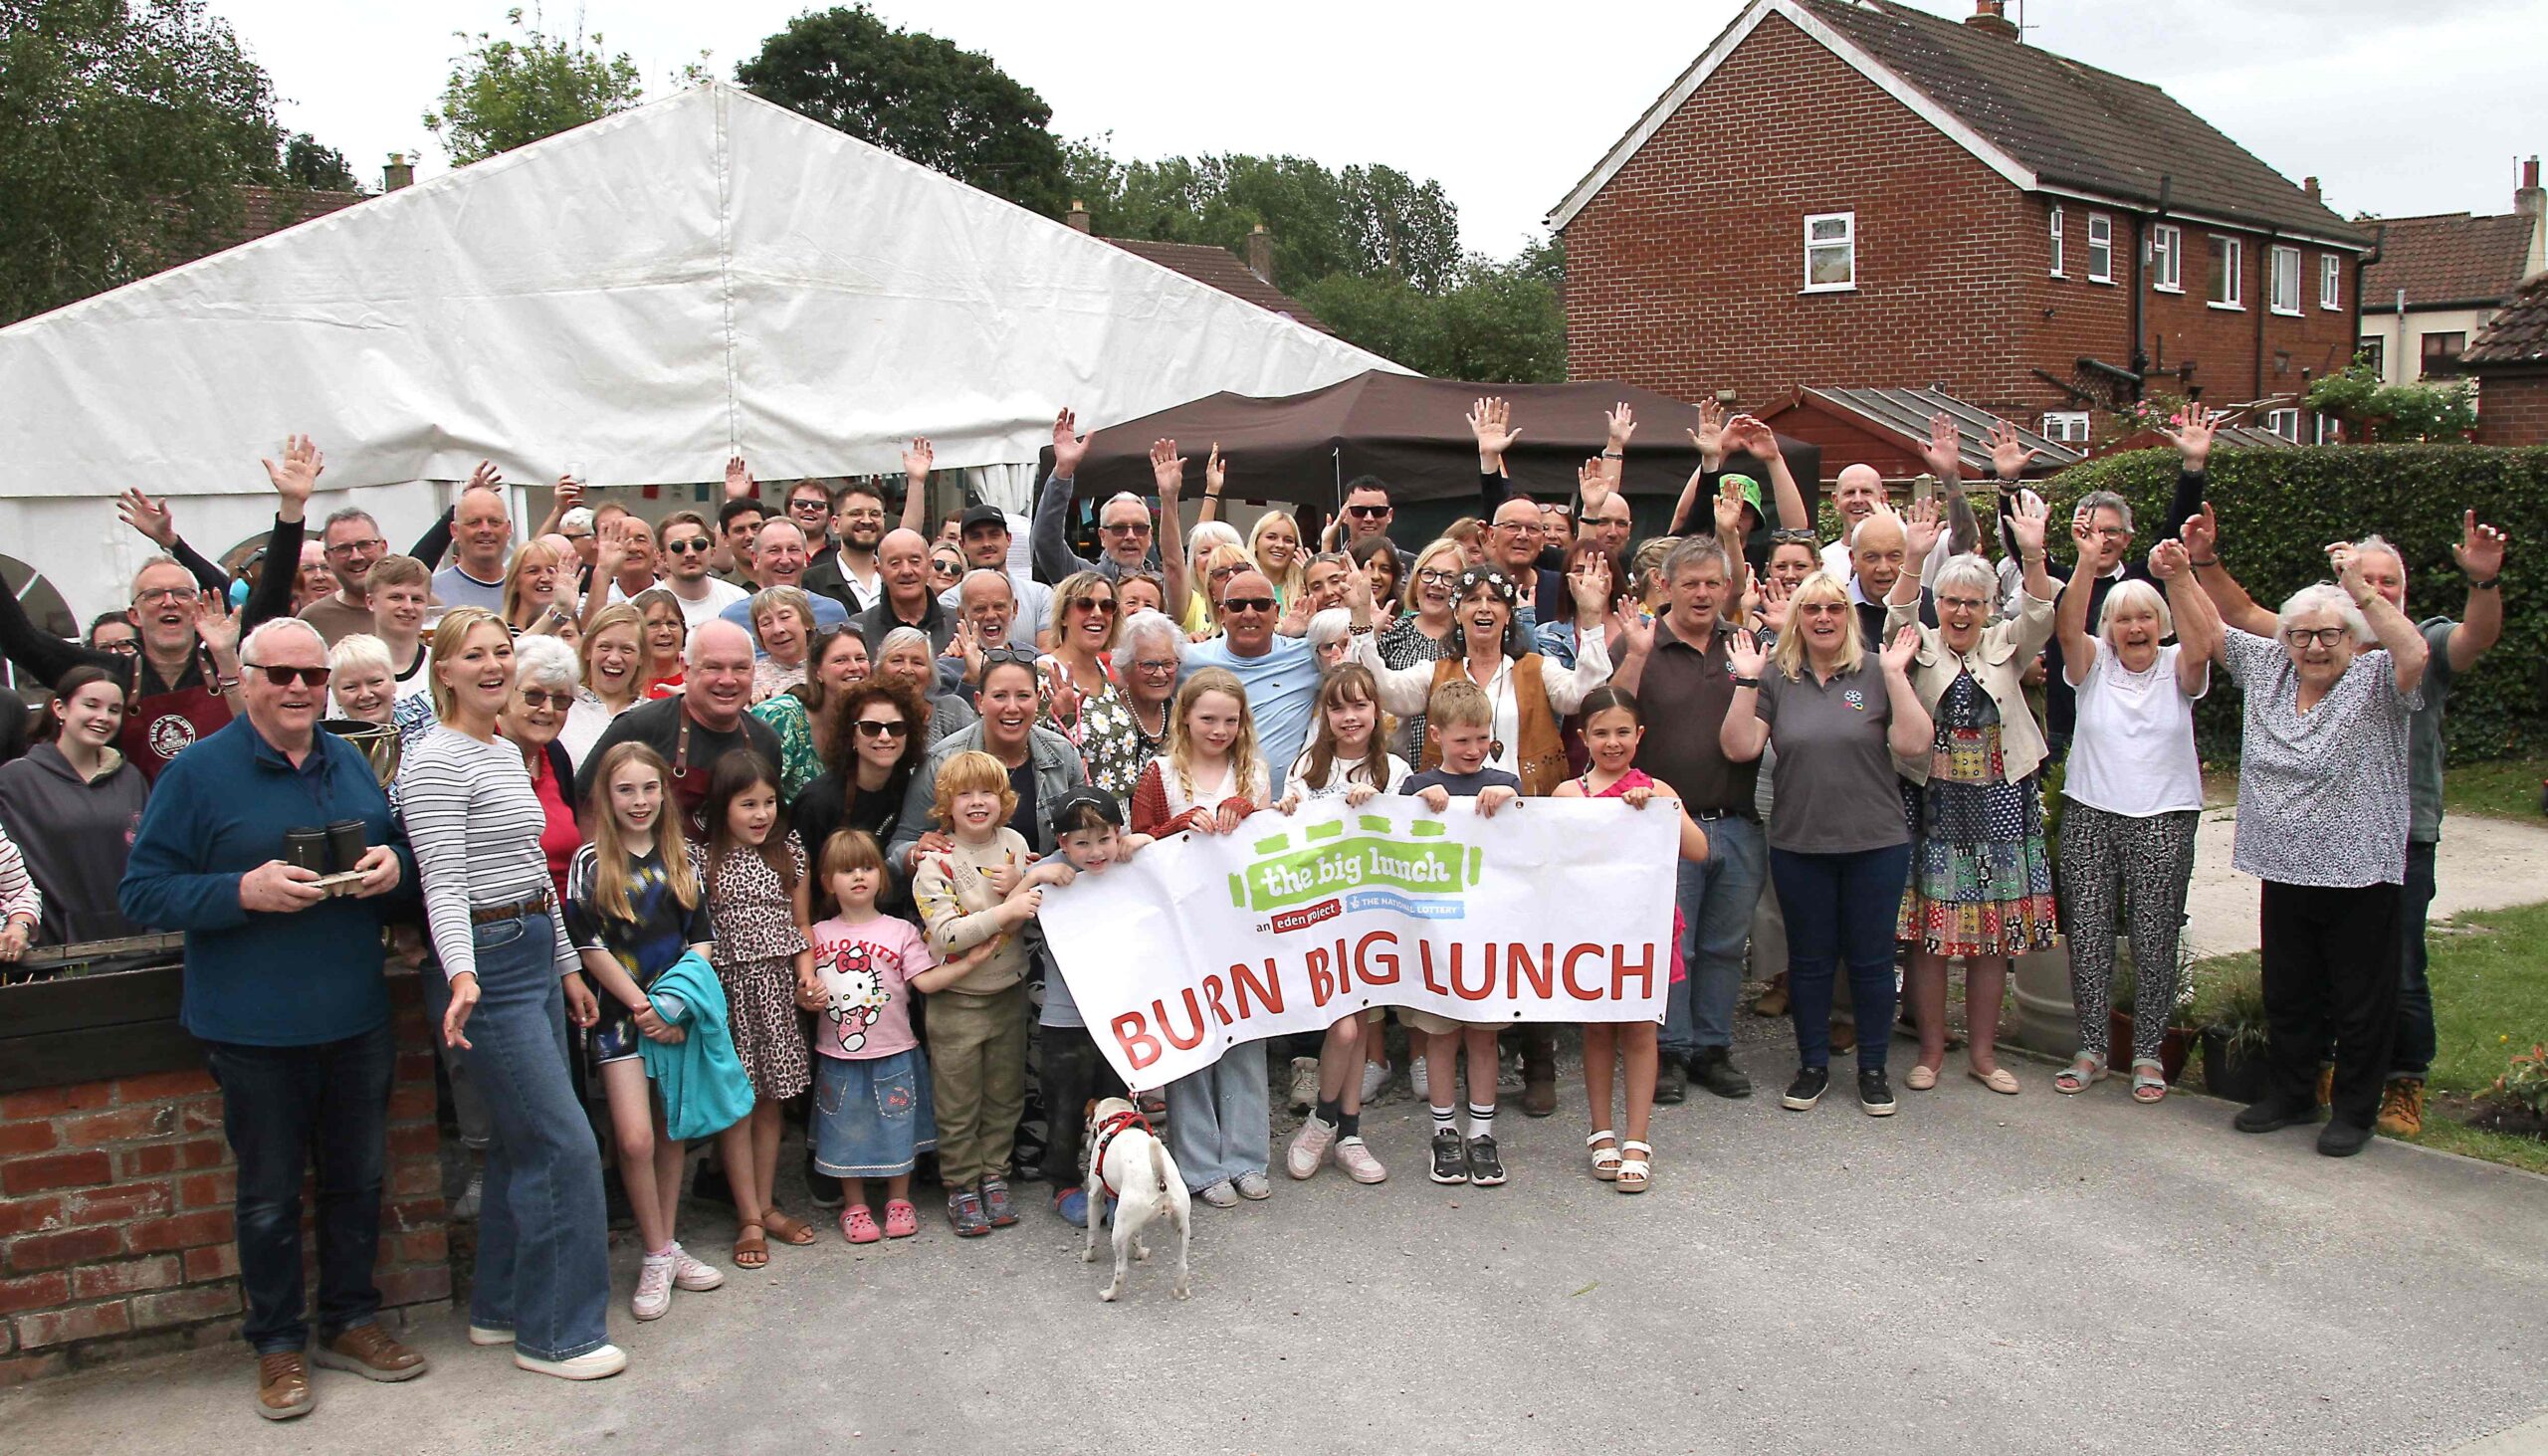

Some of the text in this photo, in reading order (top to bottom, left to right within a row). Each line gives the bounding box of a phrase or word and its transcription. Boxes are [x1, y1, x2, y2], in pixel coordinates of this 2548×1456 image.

[1260, 847, 1451, 897] the big lunch
[1256, 922, 1271, 933] an
[1277, 913, 1306, 929] eden
[814, 938, 851, 960] ELLO
[1110, 931, 1655, 1071] BURN BIG LUNCH
